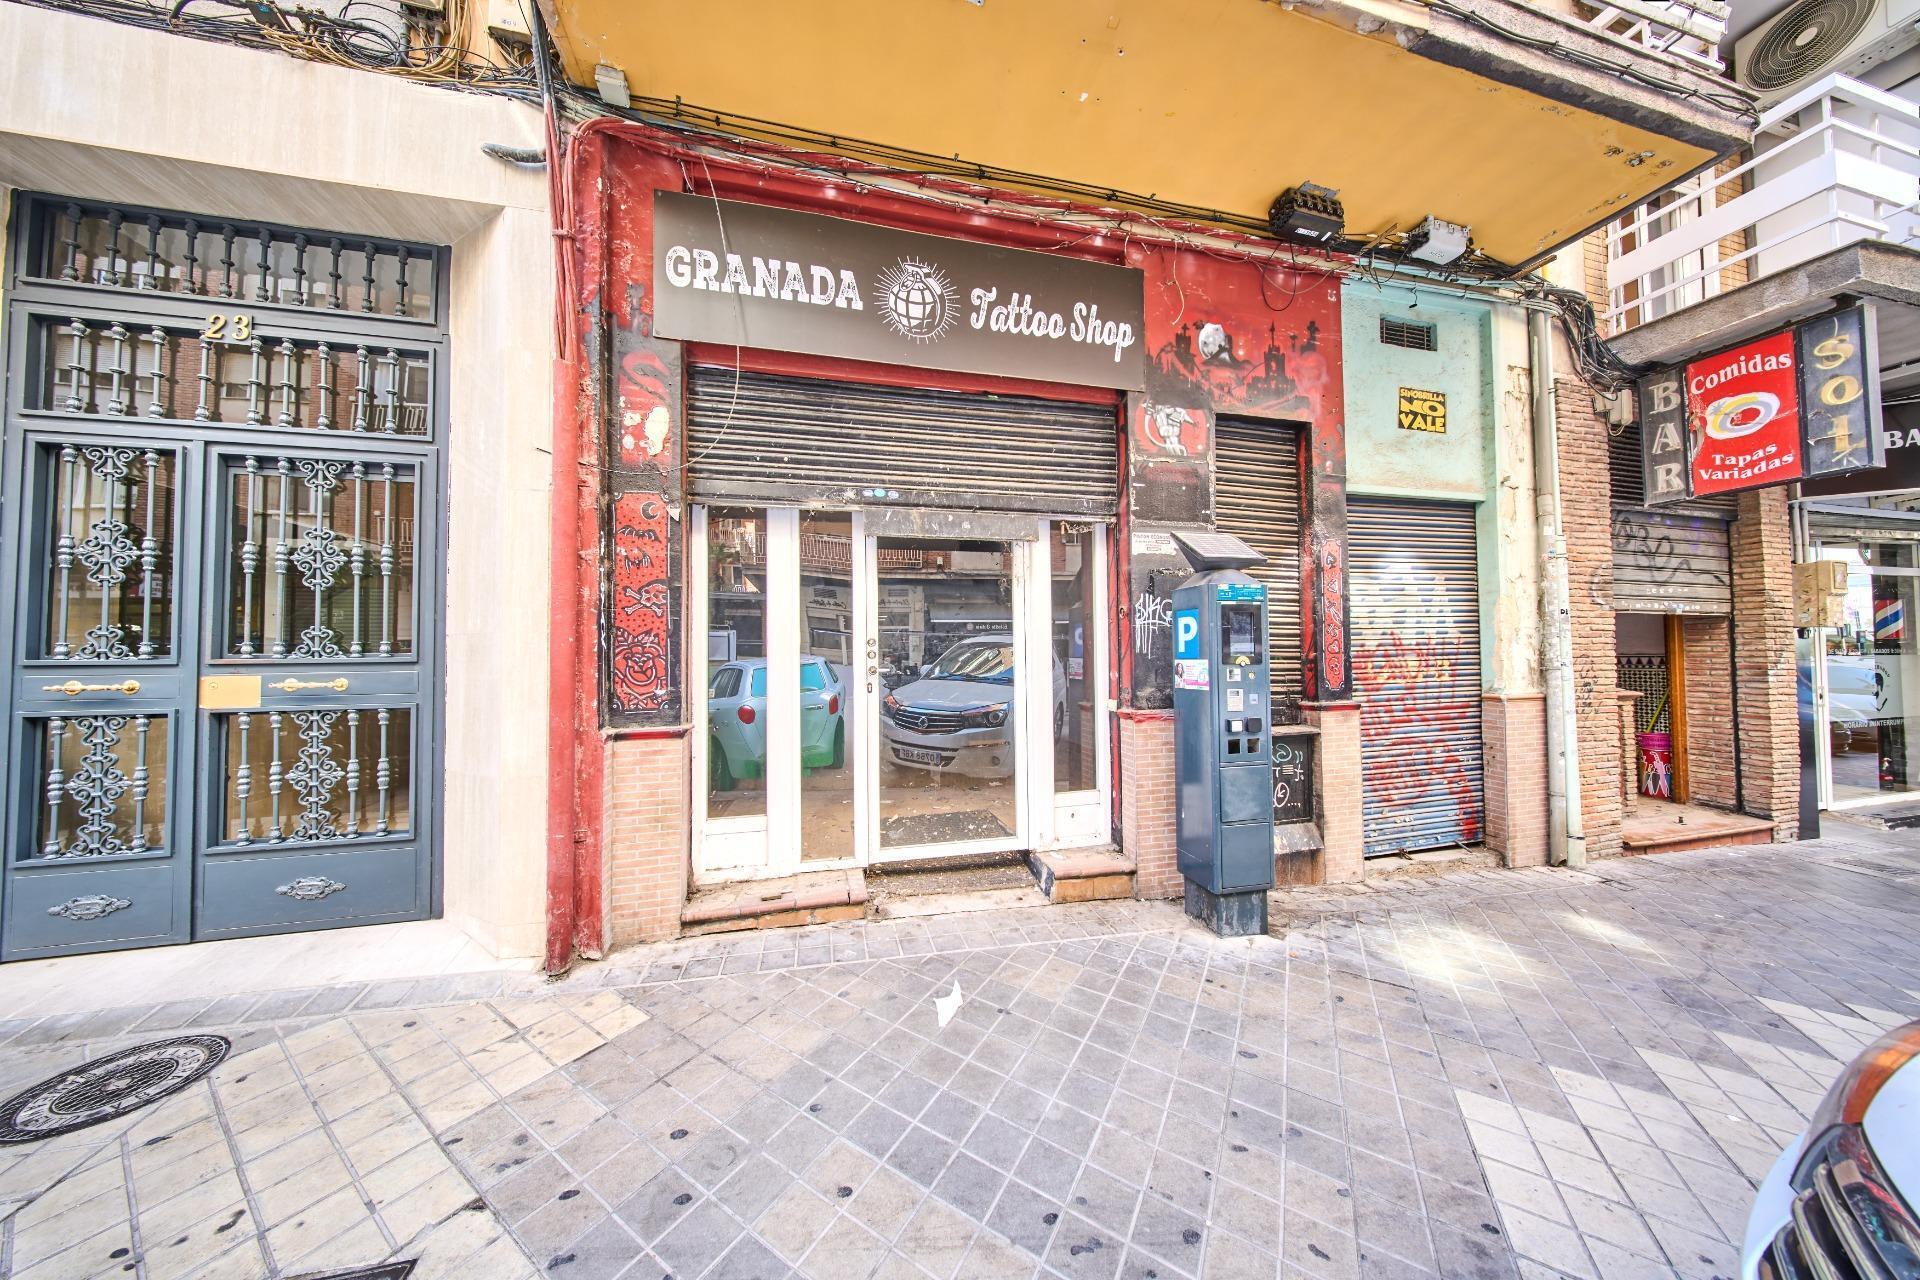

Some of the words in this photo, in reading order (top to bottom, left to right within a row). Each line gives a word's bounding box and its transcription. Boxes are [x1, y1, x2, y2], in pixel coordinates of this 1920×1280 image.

[665, 245, 864, 310] GRANADA
[970, 286, 1066, 338] Tattoo
[1070, 302, 1135, 362] Shop
[204, 313, 250, 341] 23
[1690, 353, 1792, 395] Comidas
[1400, 398, 1445, 417] NO
[1400, 412, 1445, 433] VALE
[1648, 381, 1685, 494] BAR
[1699, 453, 1794, 480] Variadas
[1712, 443, 1777, 467] Tapas
[1178, 616, 1198, 652] P
